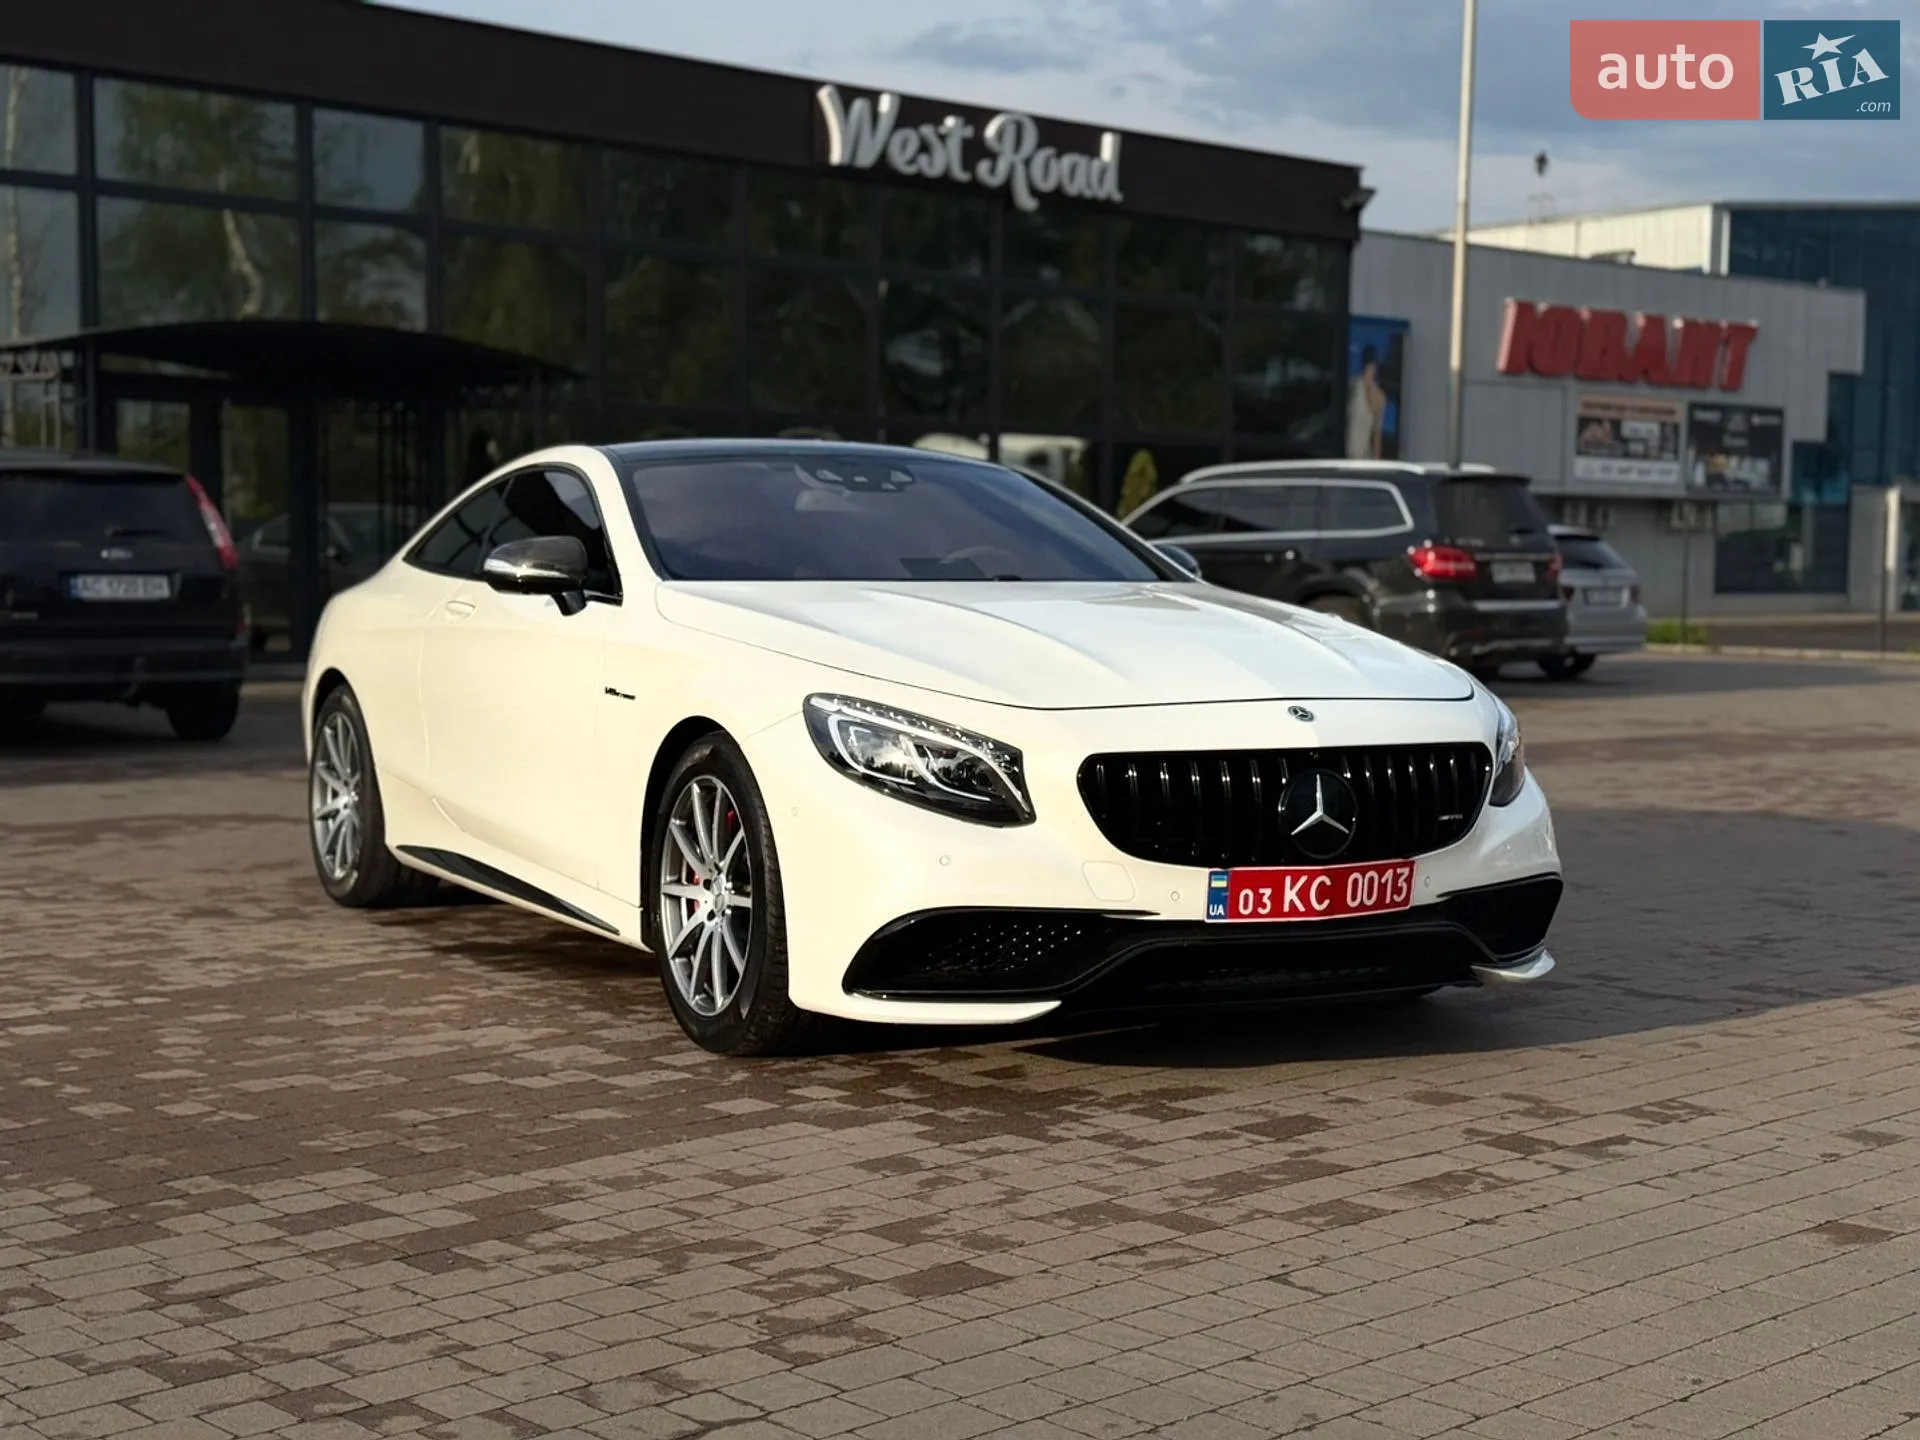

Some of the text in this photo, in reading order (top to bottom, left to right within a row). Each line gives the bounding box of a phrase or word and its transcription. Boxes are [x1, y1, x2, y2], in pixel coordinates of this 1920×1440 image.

[816, 84, 1123, 212] West Road
[1208, 904, 1226, 916] UA
[1238, 867, 1411, 915] 03 KC 0013
